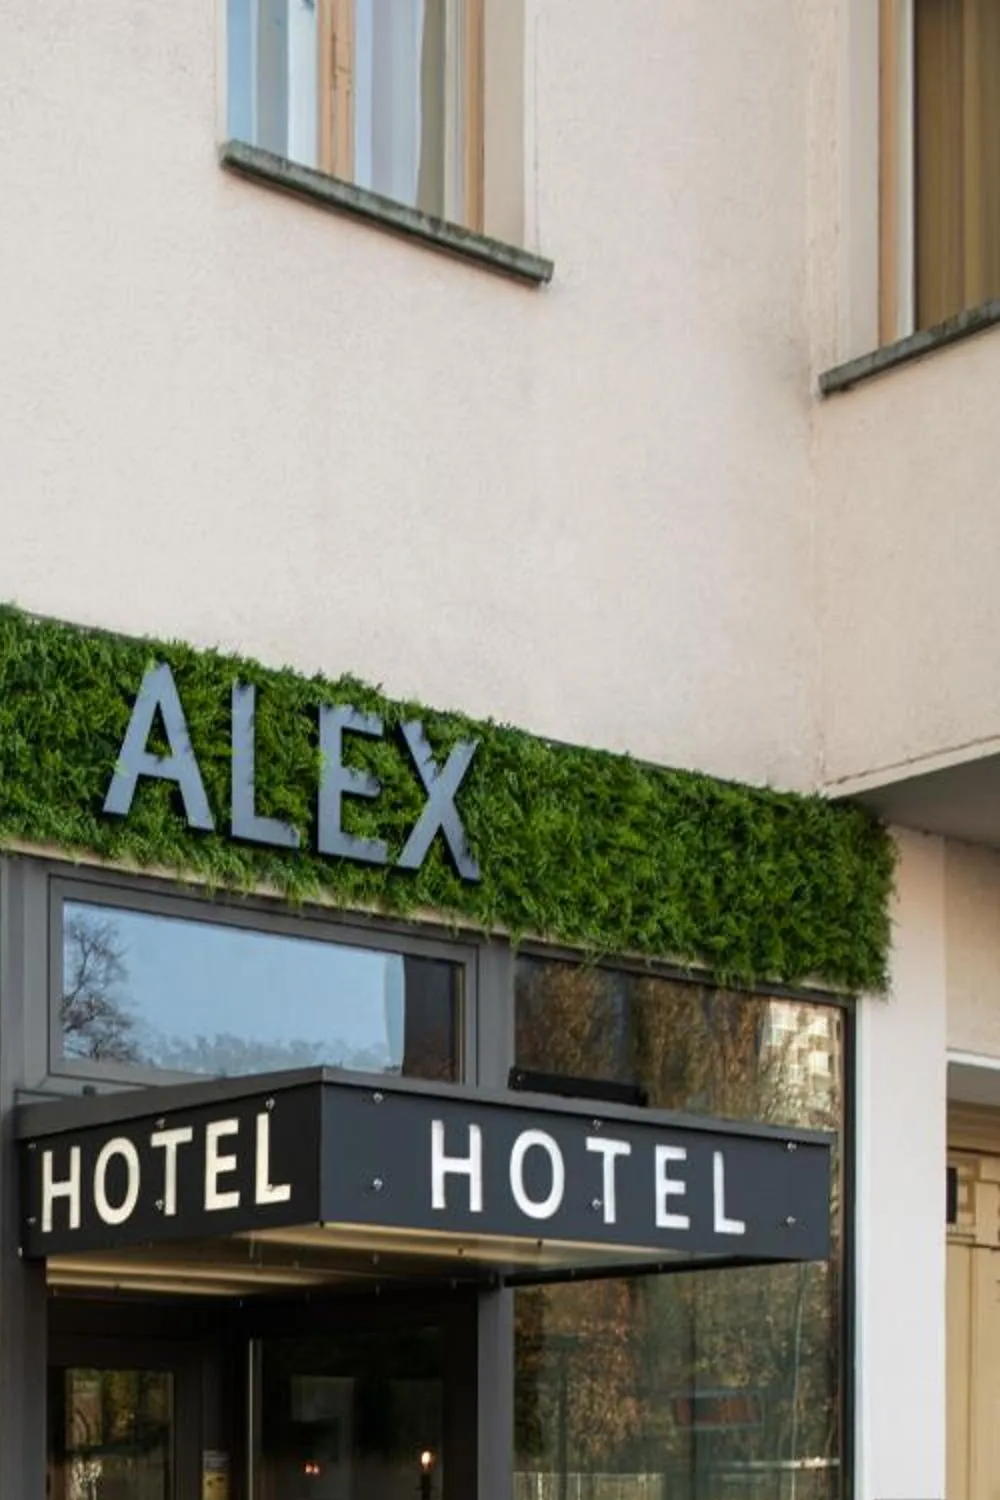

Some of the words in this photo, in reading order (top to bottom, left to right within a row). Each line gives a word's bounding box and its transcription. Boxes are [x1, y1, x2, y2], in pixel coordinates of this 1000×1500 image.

[102, 662, 480, 880] ALEX
[42, 1113, 291, 1232] HOTEL
[430, 1119, 745, 1234] HOTEL
